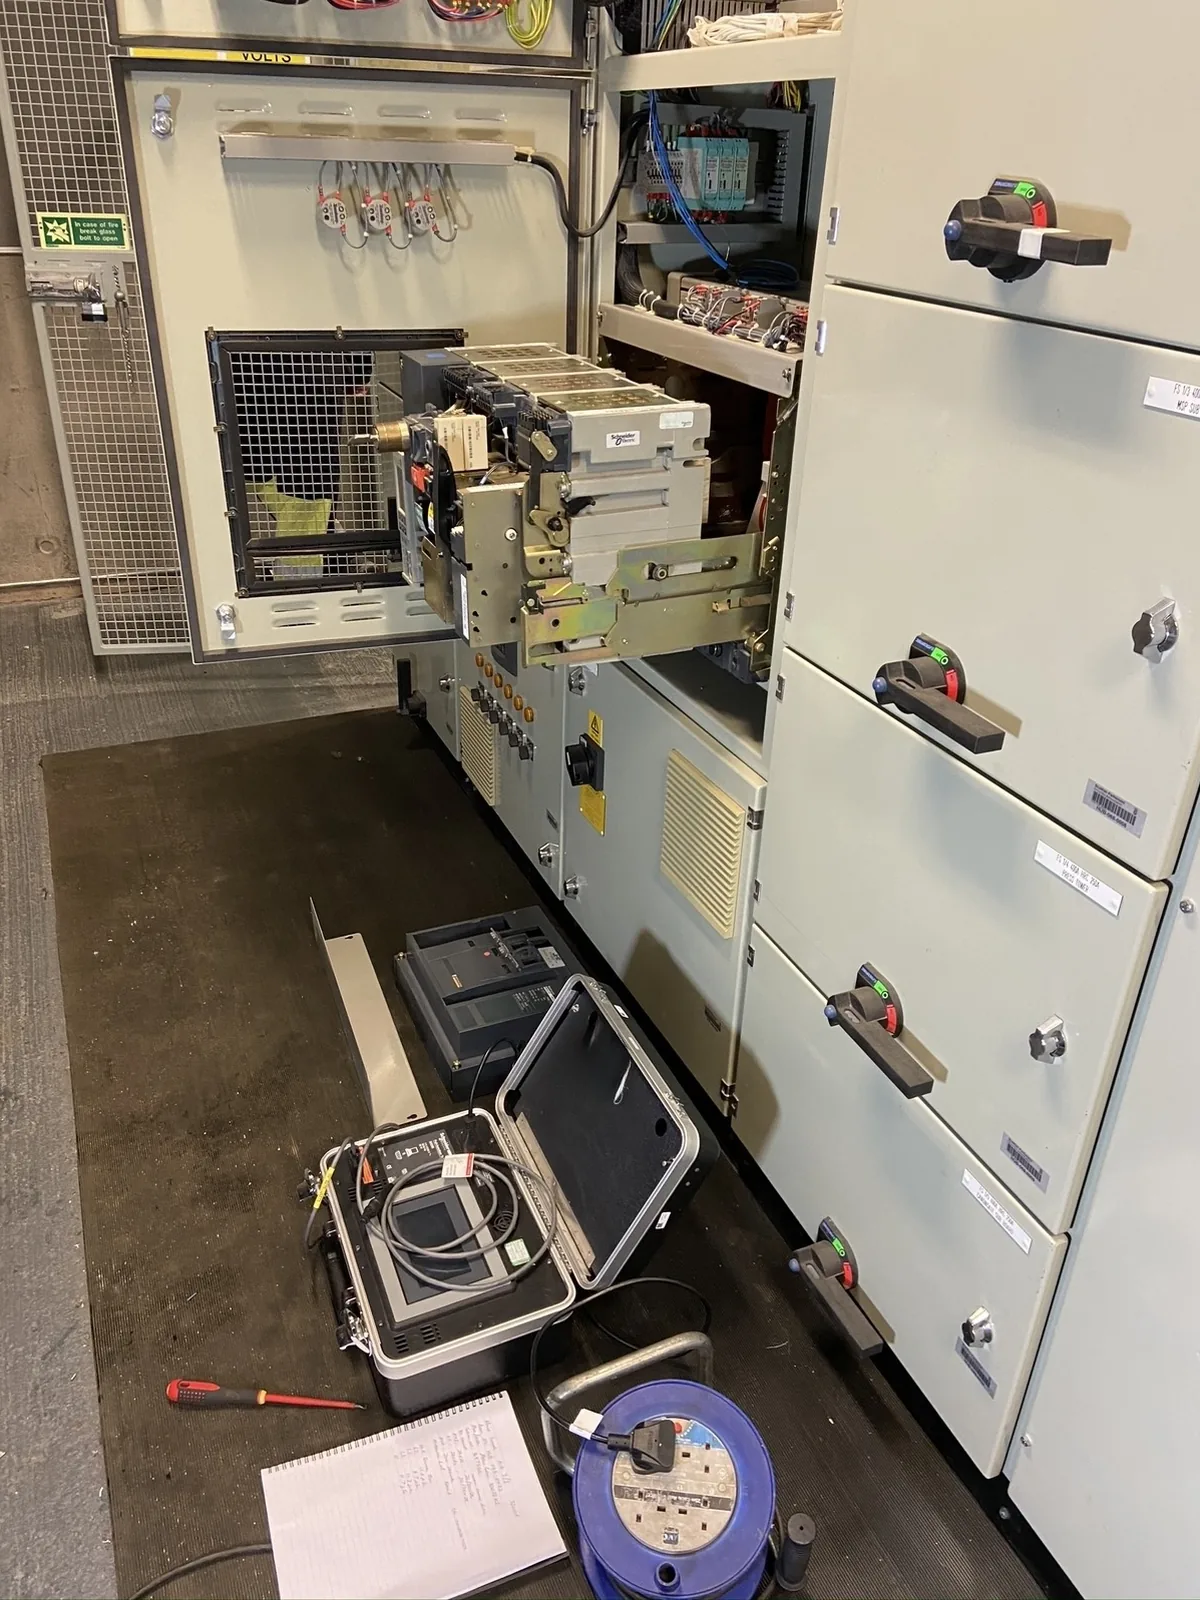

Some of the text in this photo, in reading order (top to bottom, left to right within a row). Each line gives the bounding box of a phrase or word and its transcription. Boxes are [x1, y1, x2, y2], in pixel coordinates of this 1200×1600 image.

[1173, 383, 1181, 395] FS
[1183, 385, 1191, 397] 1/3
[1177, 400, 1188, 411] MSP
